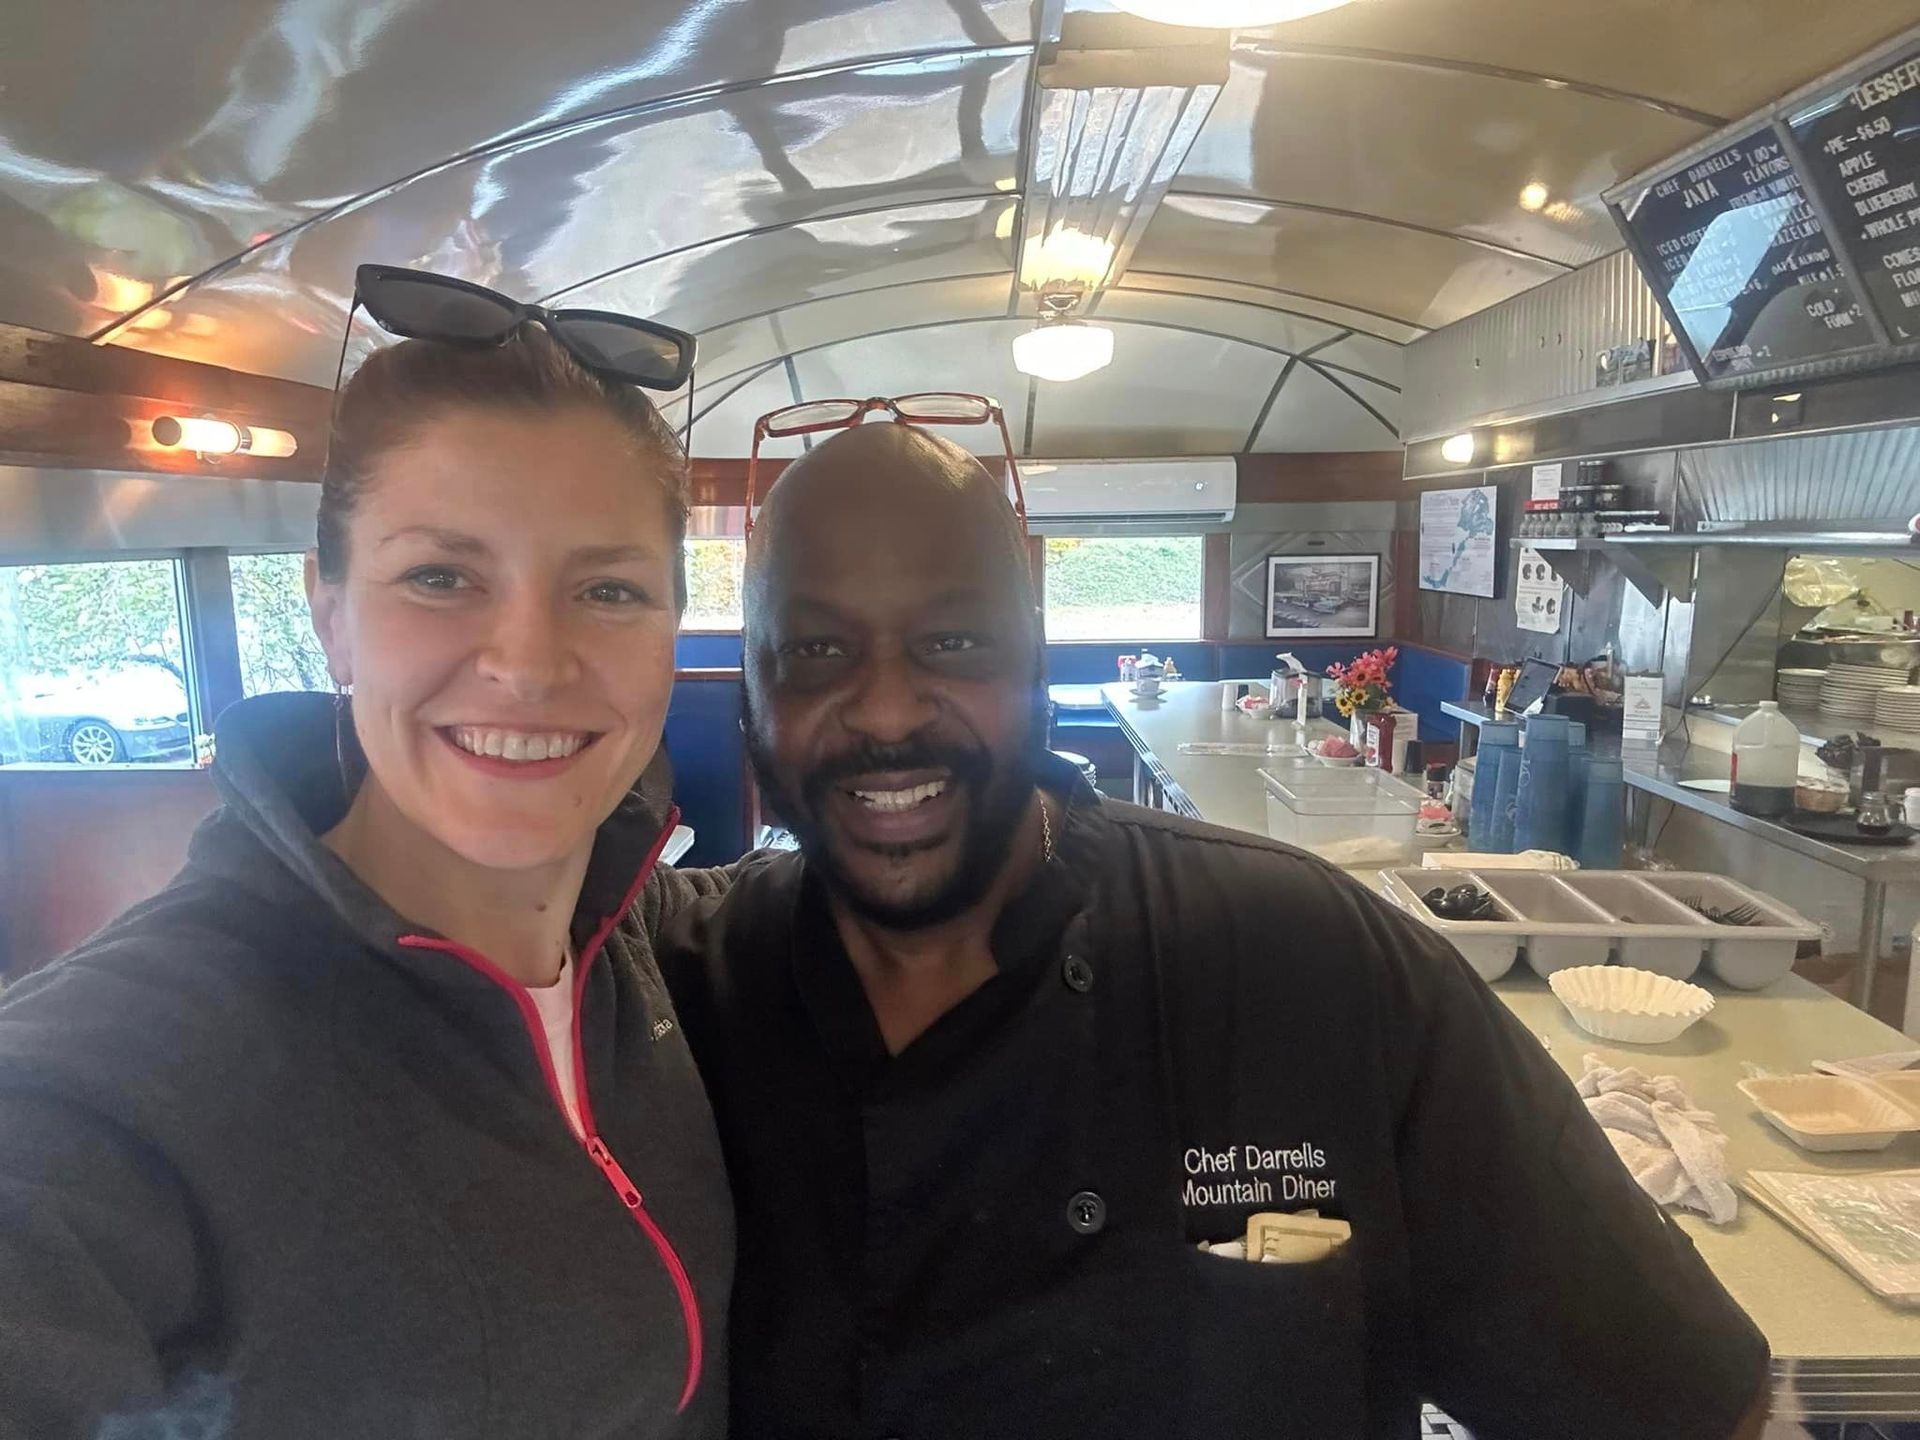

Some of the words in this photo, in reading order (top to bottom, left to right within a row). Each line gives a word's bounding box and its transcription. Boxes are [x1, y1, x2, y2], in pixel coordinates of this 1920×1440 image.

[1839, 150, 1876, 178] APPLE
[1683, 179, 1719, 208] JAVA
[1846, 169, 1889, 196] CHERRY
[1854, 182, 1918, 216] BLUEBERRY
[1806, 299, 1835, 317] COLD
[1185, 1146, 1237, 1174] Chef
[1245, 1142, 1326, 1170] Darrells
[1182, 1177, 1272, 1206] Mountain
[1282, 1174, 1336, 1200] Diner
